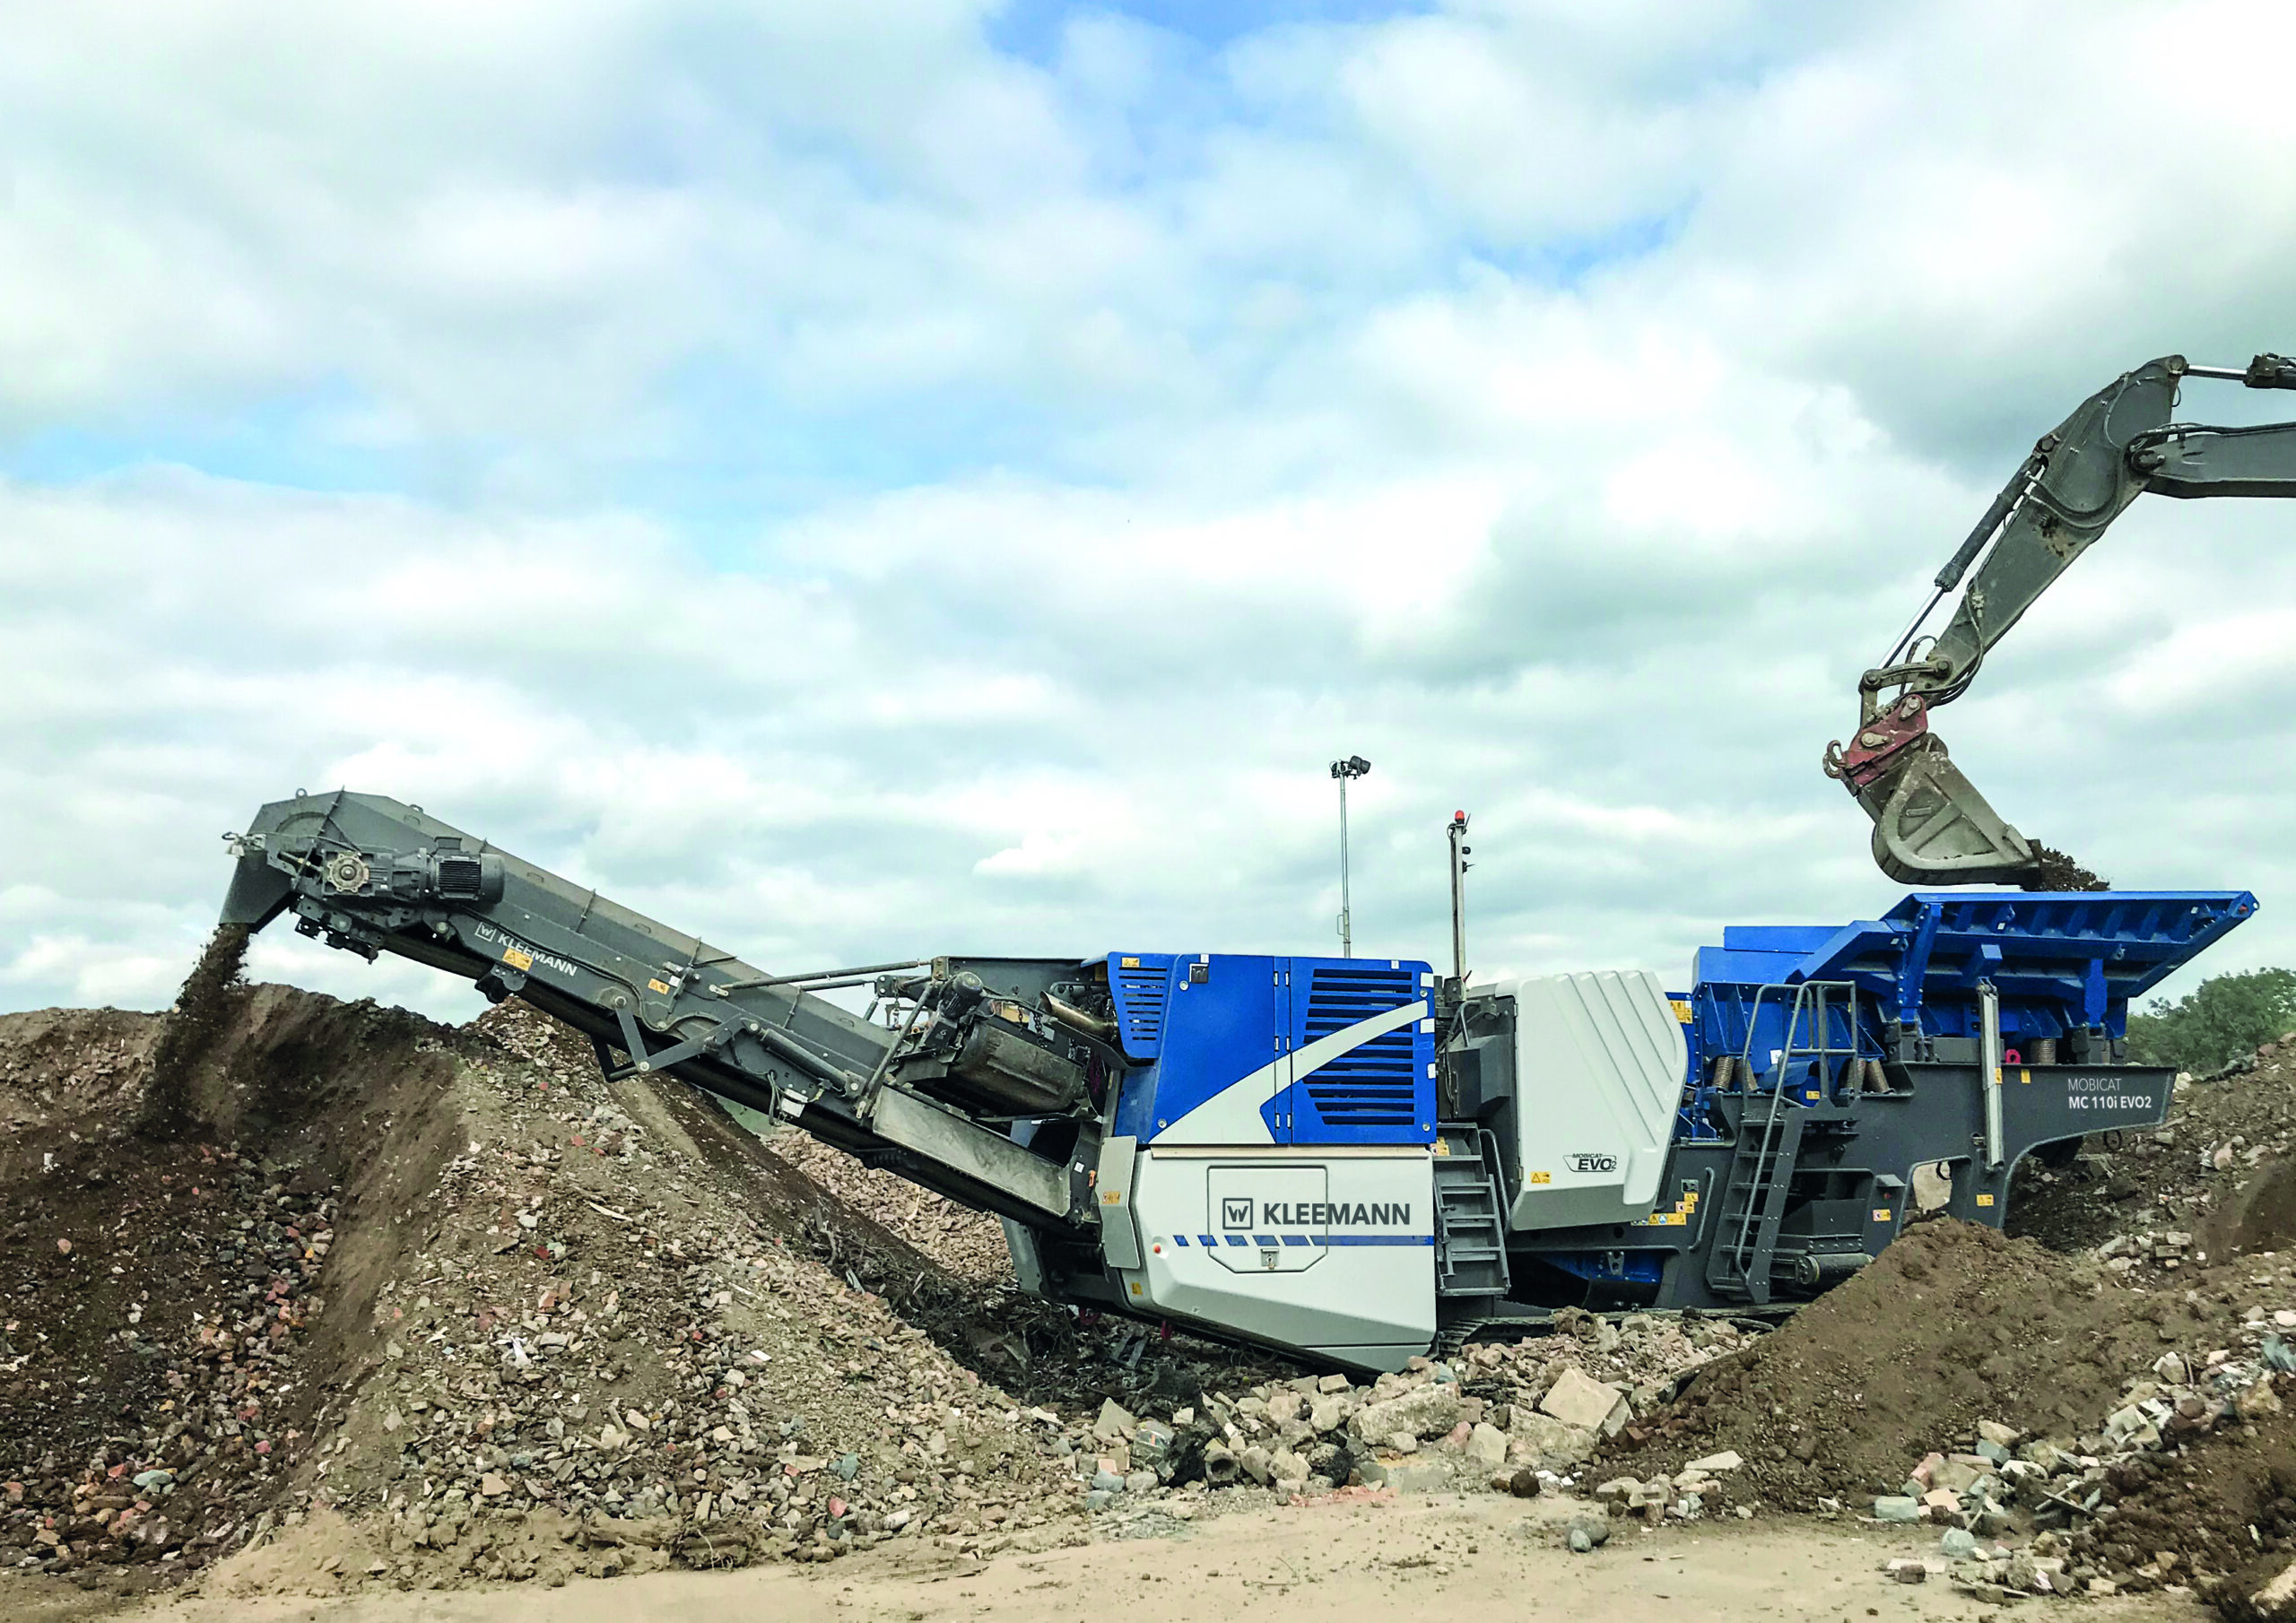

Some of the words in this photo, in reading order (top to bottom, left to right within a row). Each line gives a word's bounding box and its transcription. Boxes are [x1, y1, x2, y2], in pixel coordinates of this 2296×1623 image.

[497, 933, 578, 977] KLEEMANN
[2067, 1078, 2122, 1091] MOBICAT
[2068, 1096, 2089, 1109] MC
[2092, 1096, 2118, 1109] 110i
[2120, 1096, 2152, 1109] EVO2
[1264, 1203, 1411, 1225] KLEEMANN
